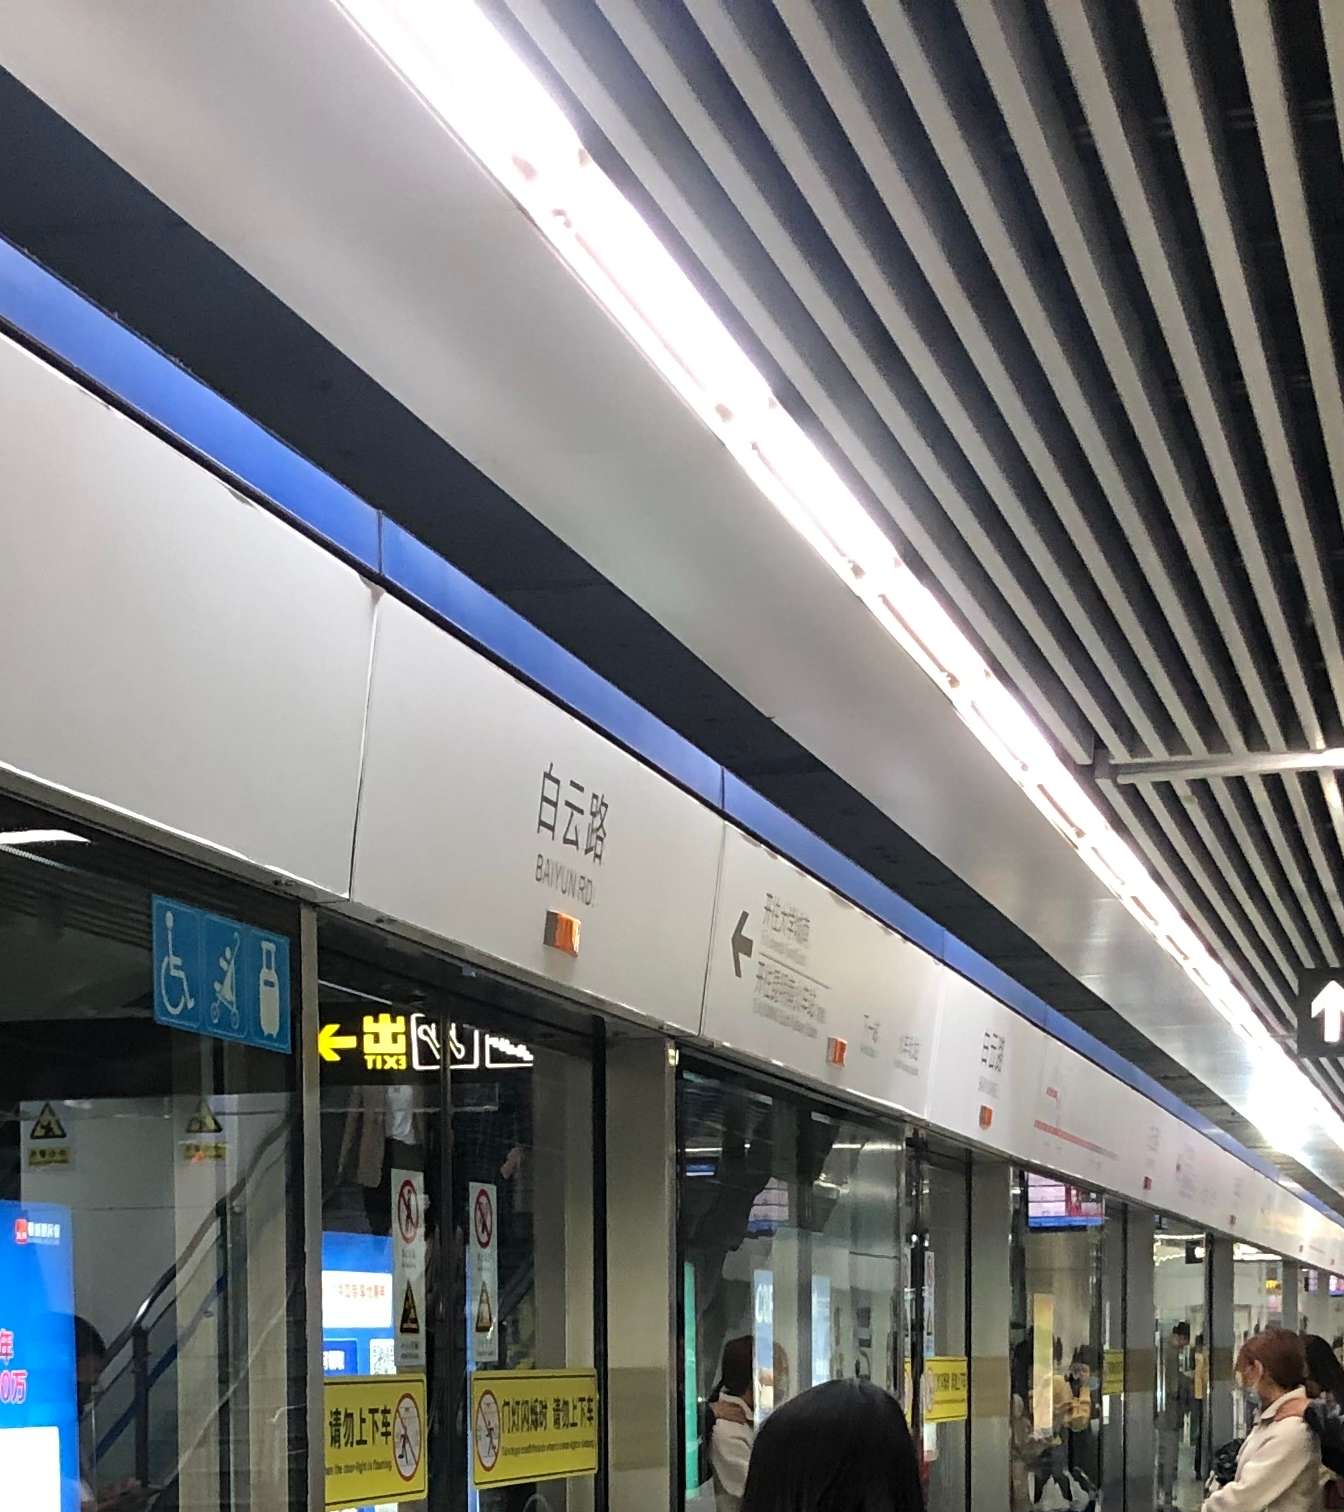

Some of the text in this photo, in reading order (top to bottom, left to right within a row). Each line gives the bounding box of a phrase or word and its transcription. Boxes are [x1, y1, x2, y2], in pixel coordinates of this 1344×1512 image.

[537, 762, 608, 865] 白云路
[535, 853, 577, 898] BAIYUN
[329, 1405, 392, 1449] 请勿上下车
